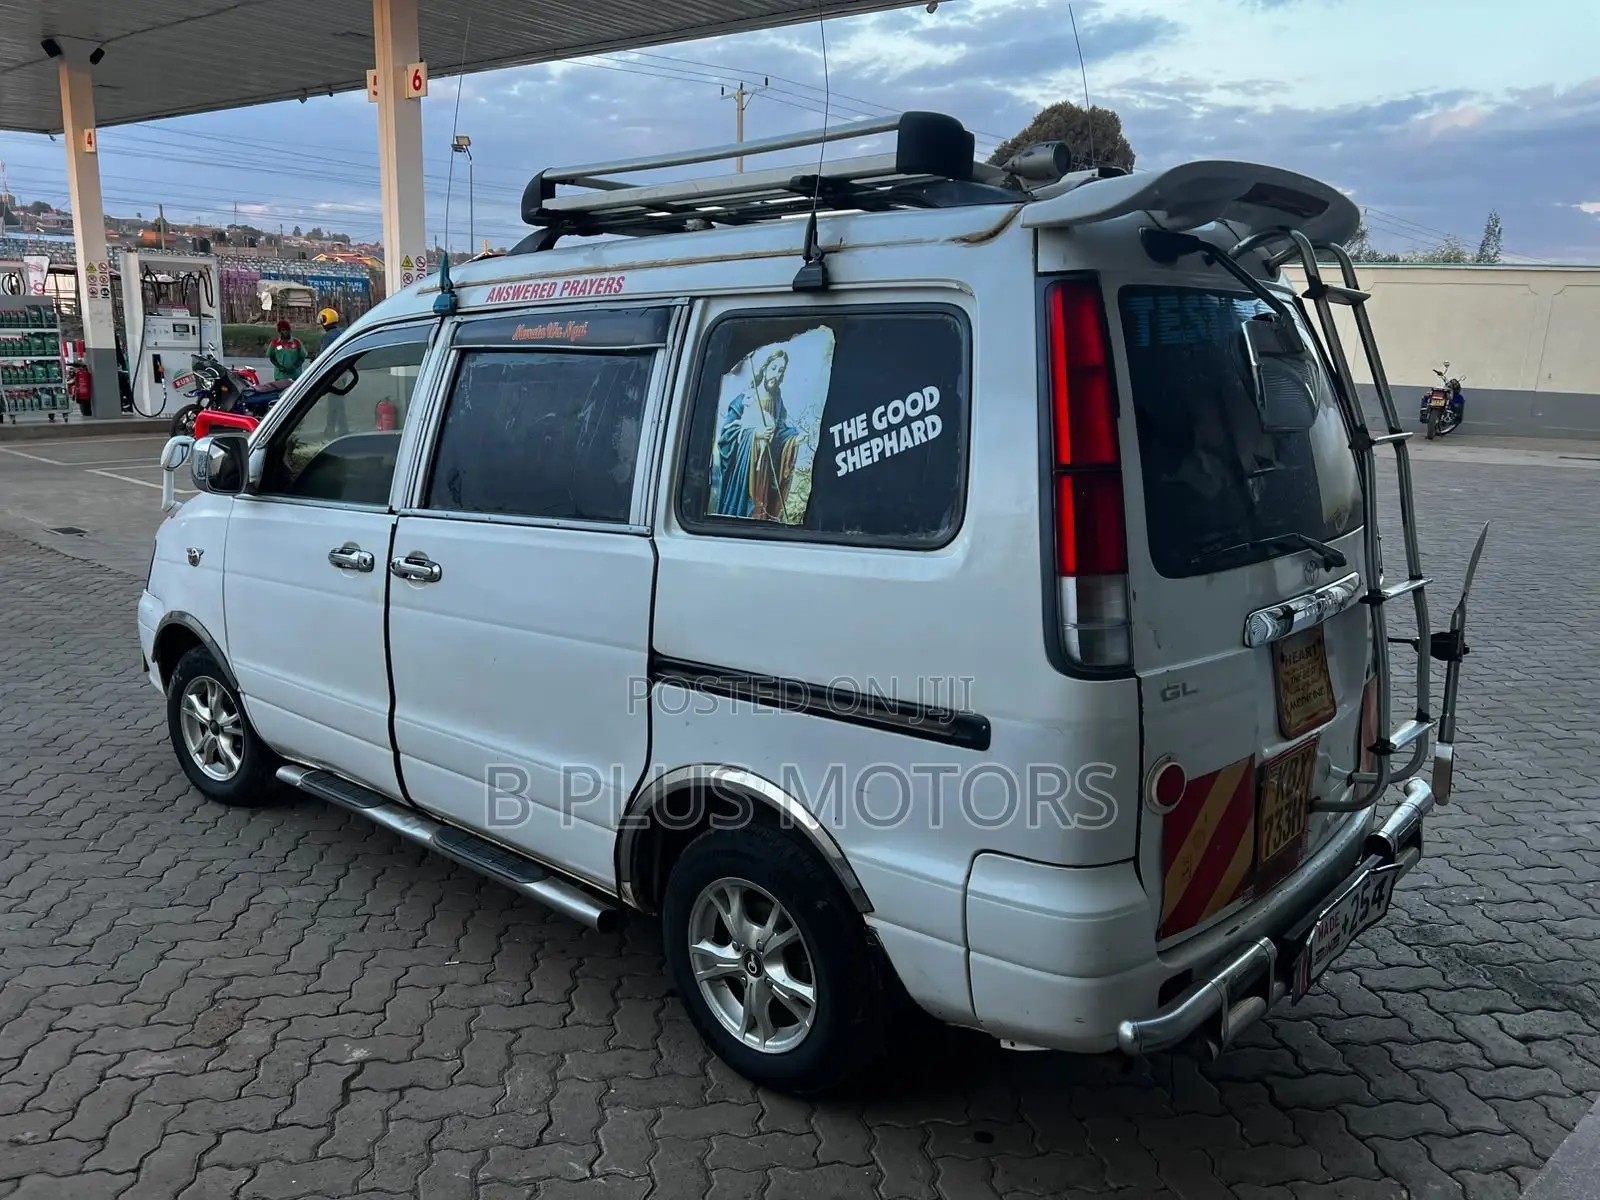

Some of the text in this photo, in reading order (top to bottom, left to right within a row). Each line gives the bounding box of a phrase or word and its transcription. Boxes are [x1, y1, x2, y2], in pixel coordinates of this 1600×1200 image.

[412, 68, 422, 91] 6
[86, 132, 93, 147] 4
[486, 276, 626, 302] ANSWERED PRAYERS
[829, 386, 940, 448] THE GOOD
[835, 414, 943, 477] SHEPHARD
[1285, 644, 1317, 666] HEART
[1160, 681, 1198, 702] GL
[1318, 911, 1341, 938] MADE
